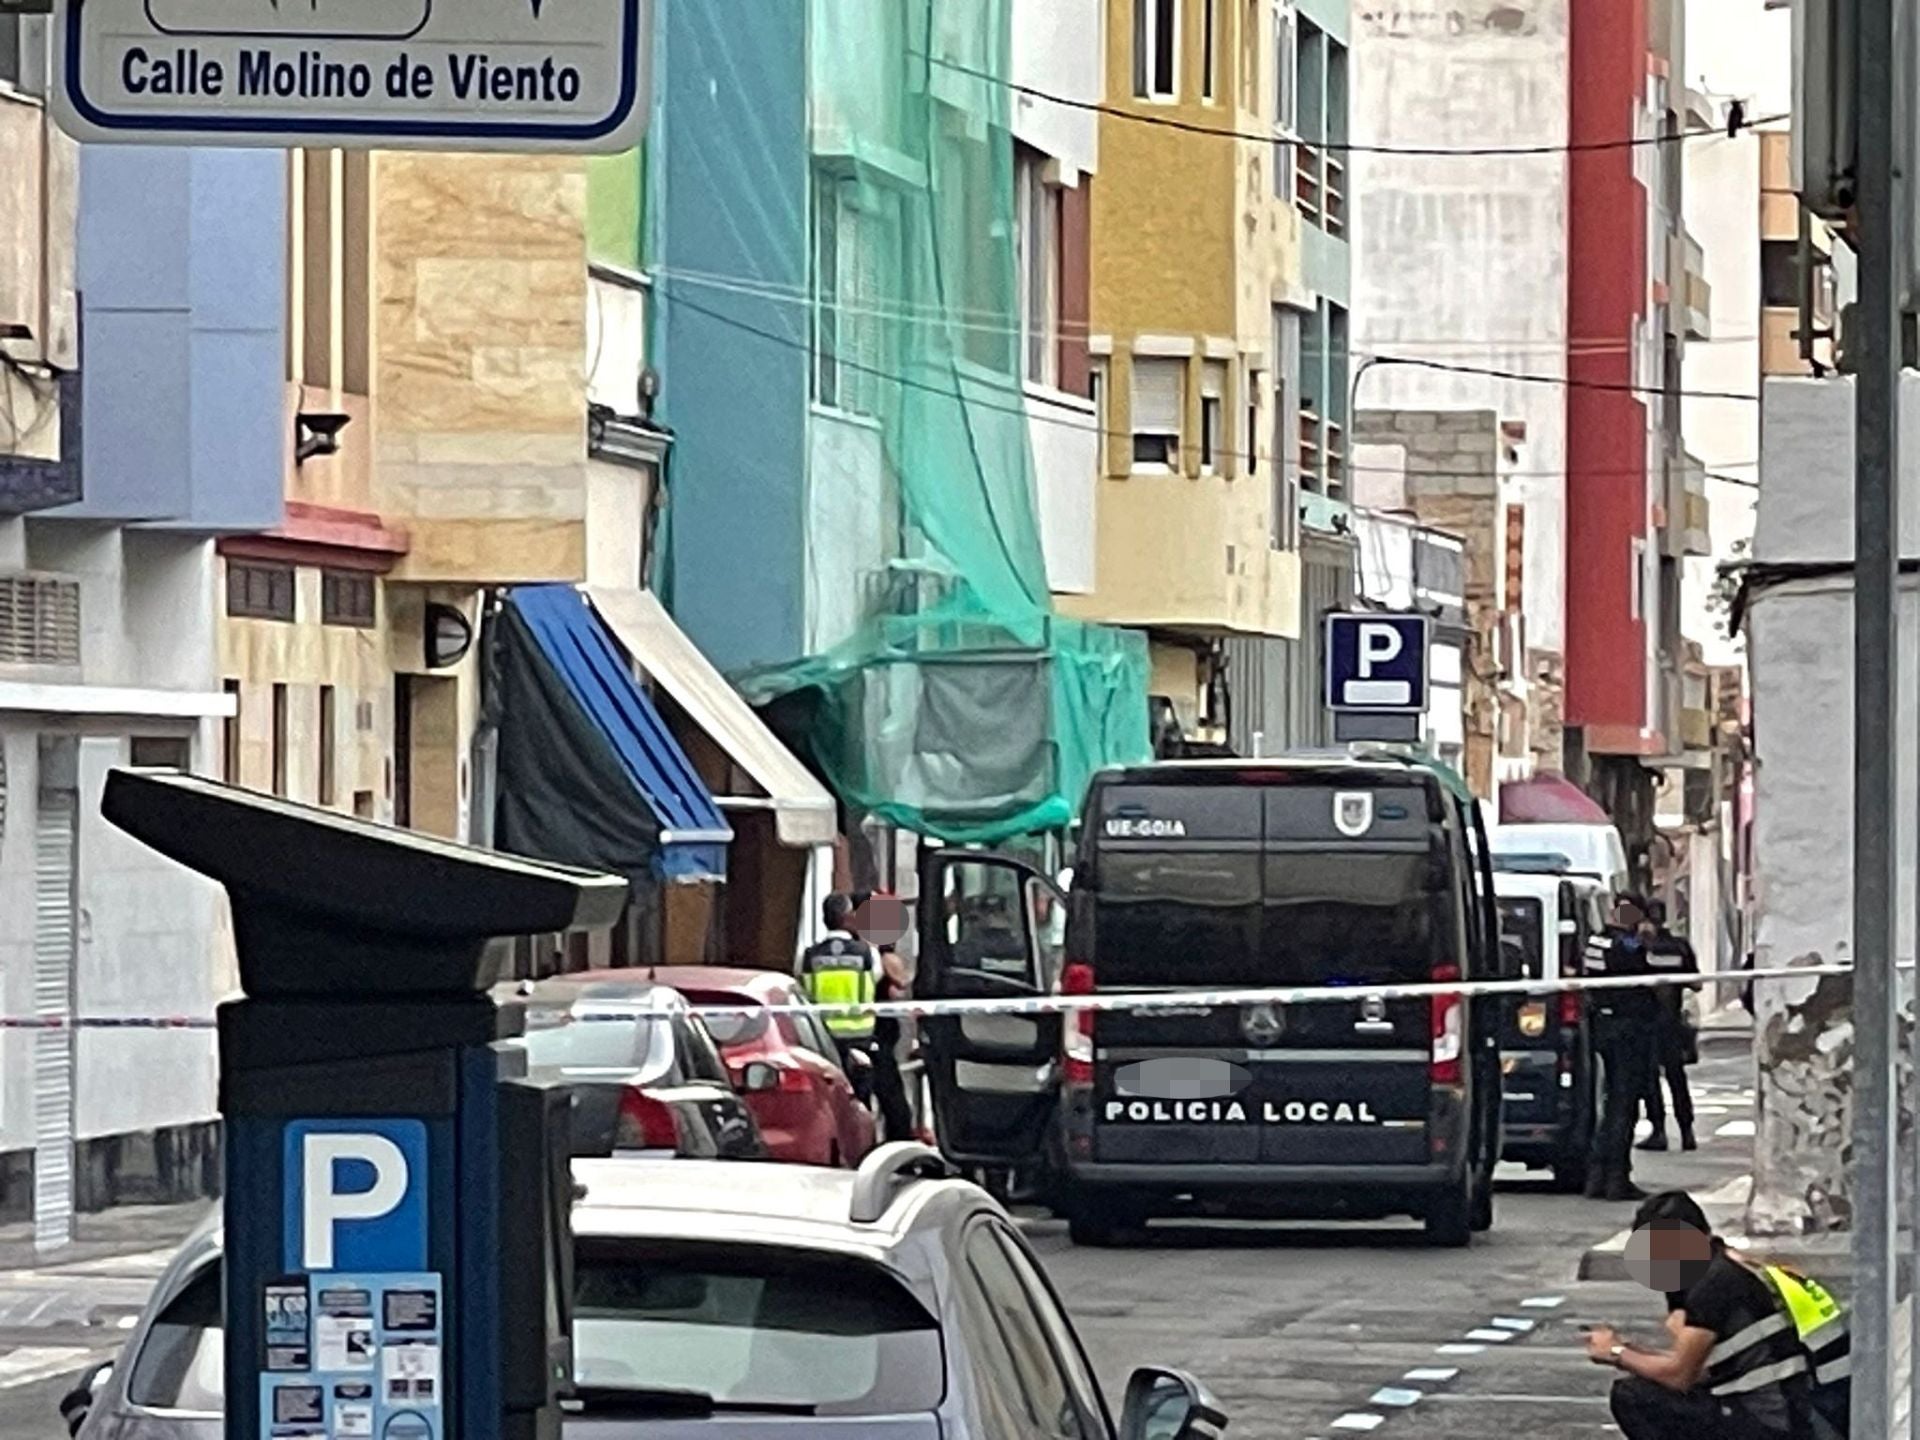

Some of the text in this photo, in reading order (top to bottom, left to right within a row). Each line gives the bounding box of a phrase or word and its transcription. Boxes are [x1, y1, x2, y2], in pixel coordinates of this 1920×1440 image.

[121, 46, 580, 102] Calle Molino de Viento
[1358, 622, 1403, 679] P
[1105, 818, 1187, 837] UE-GOIA
[1105, 1101, 1377, 1122] POLICIA LOCAL
[302, 1132, 409, 1270] P
